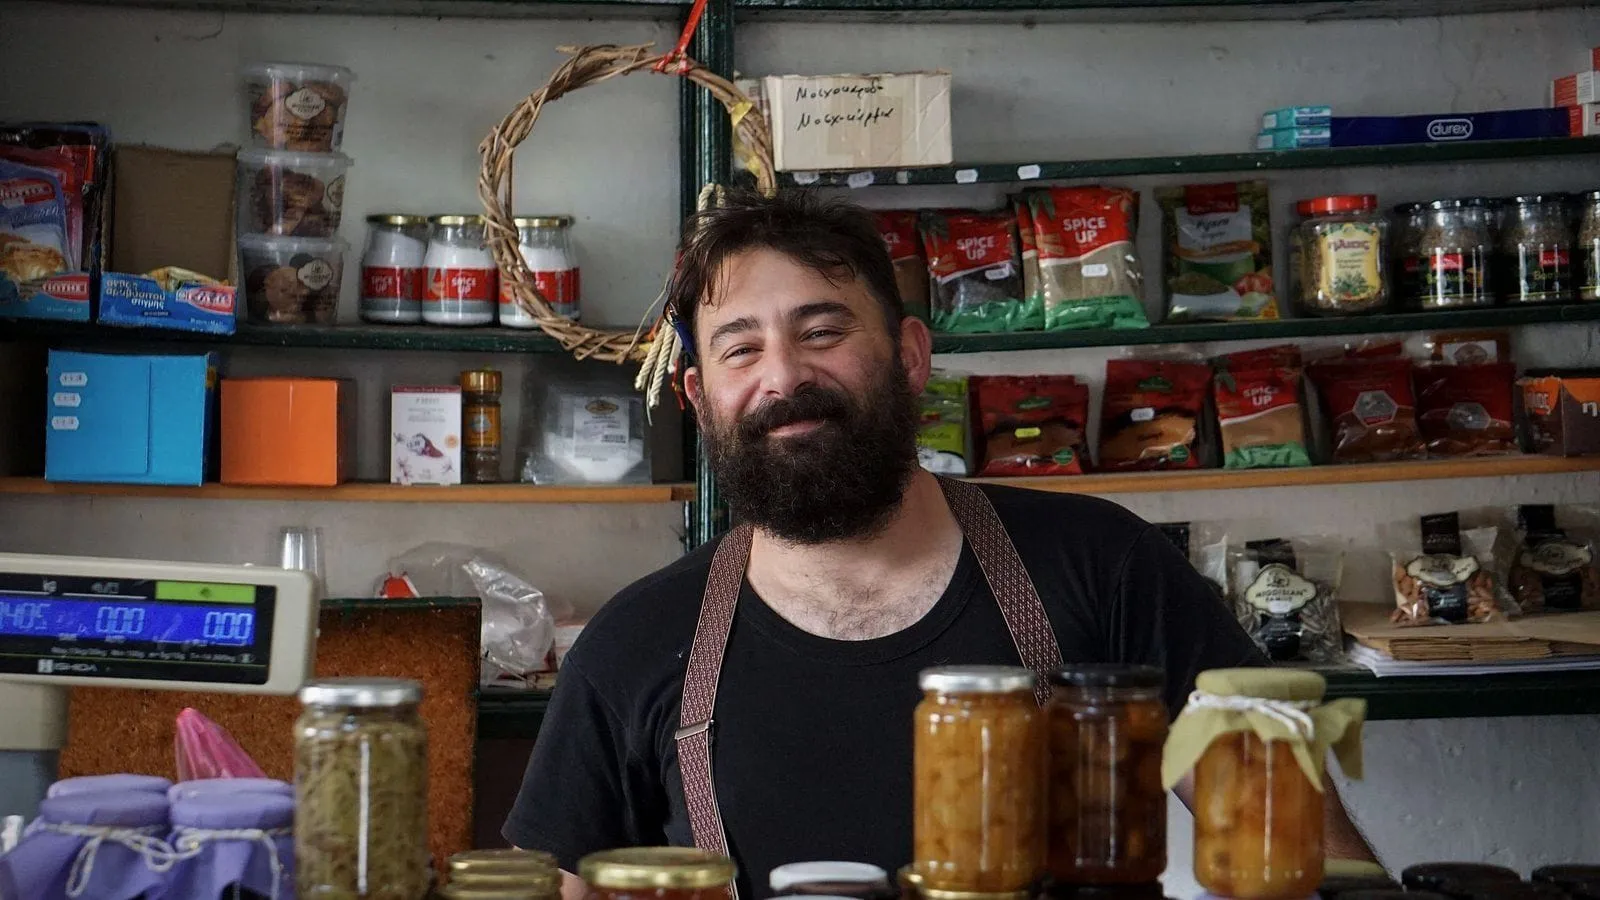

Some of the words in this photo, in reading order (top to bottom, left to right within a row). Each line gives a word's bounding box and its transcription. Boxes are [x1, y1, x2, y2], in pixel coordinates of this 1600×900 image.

[1431, 120, 1469, 137] durex
[1062, 216, 1107, 232] SPICE
[956, 235, 995, 251] SPICE
[1074, 230, 1097, 244] UP
[966, 248, 986, 261] UP
[371, 275, 393, 286] SPICE
[451, 276, 476, 288] SPICE
[375, 285, 388, 294] UP
[457, 286, 472, 296] UP
[1243, 386, 1280, 398] SPICE
[1252, 395, 1273, 406] UP
